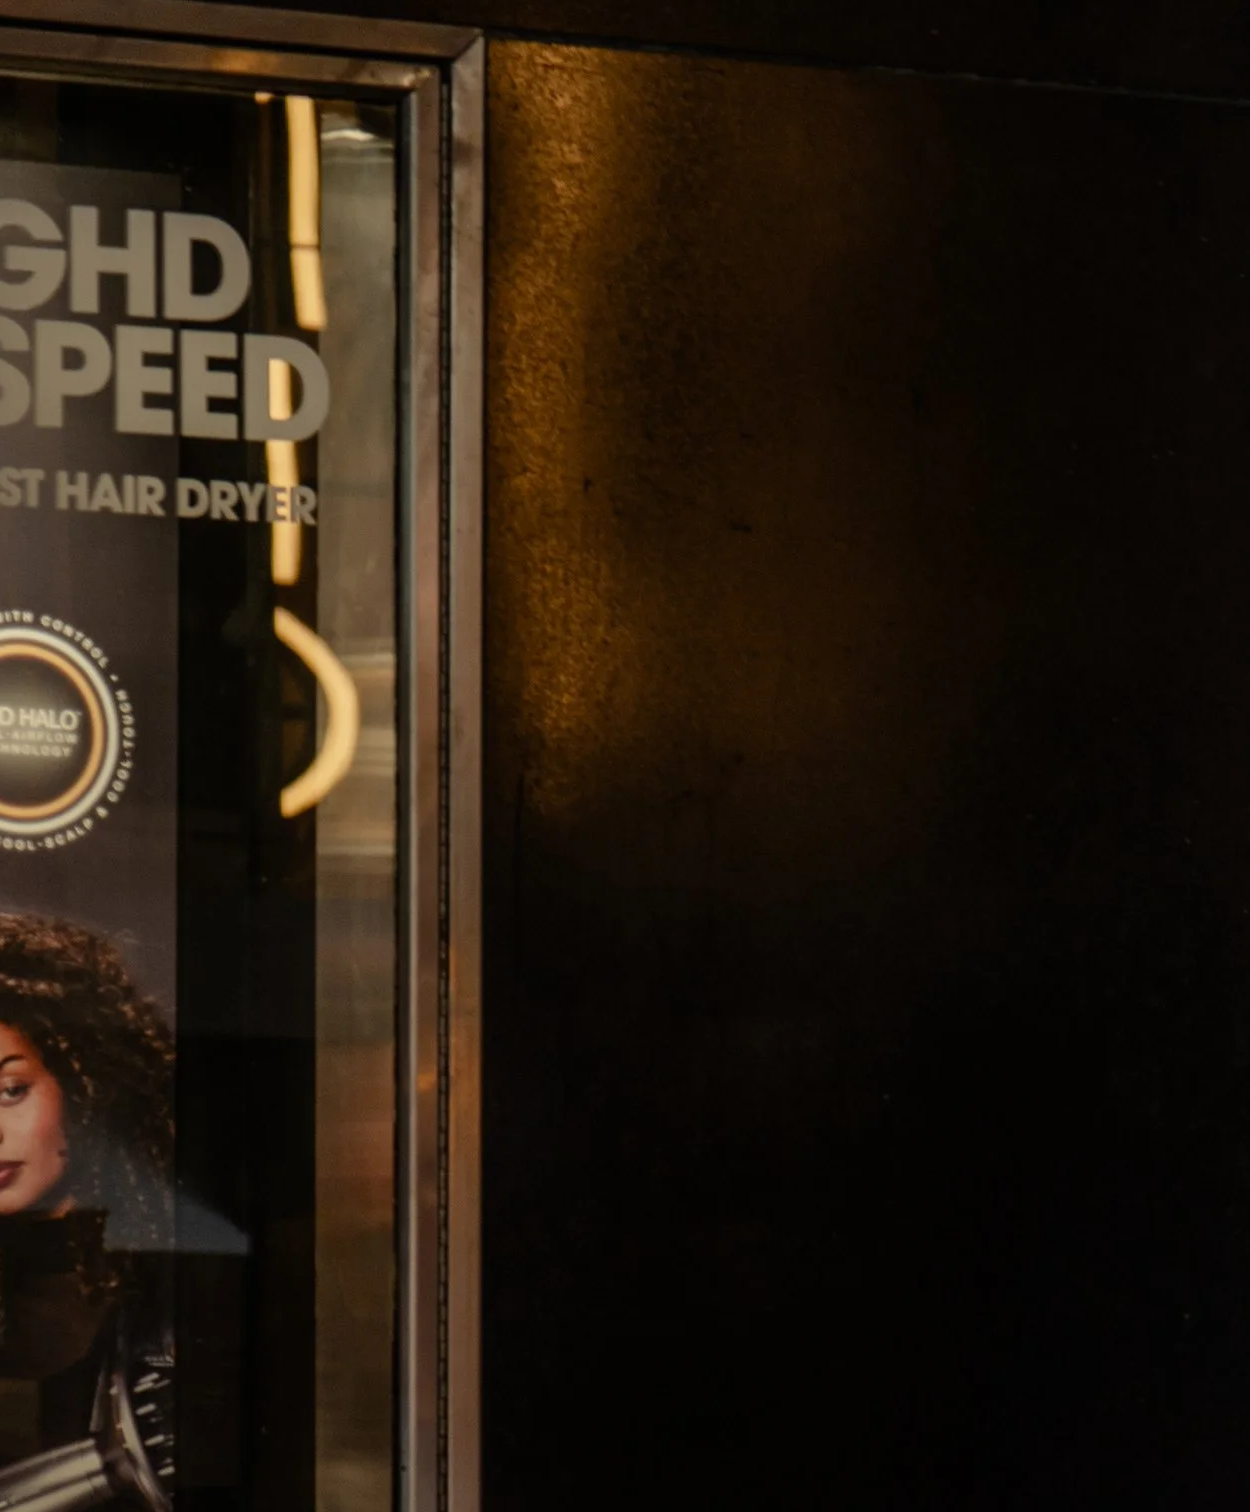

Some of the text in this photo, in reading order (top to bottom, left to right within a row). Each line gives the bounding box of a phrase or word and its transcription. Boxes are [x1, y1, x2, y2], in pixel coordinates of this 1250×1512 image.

[54, 469, 167, 518] HAIR
[175, 477, 318, 527] DRYER
[40, 614, 110, 669] CONTROL
